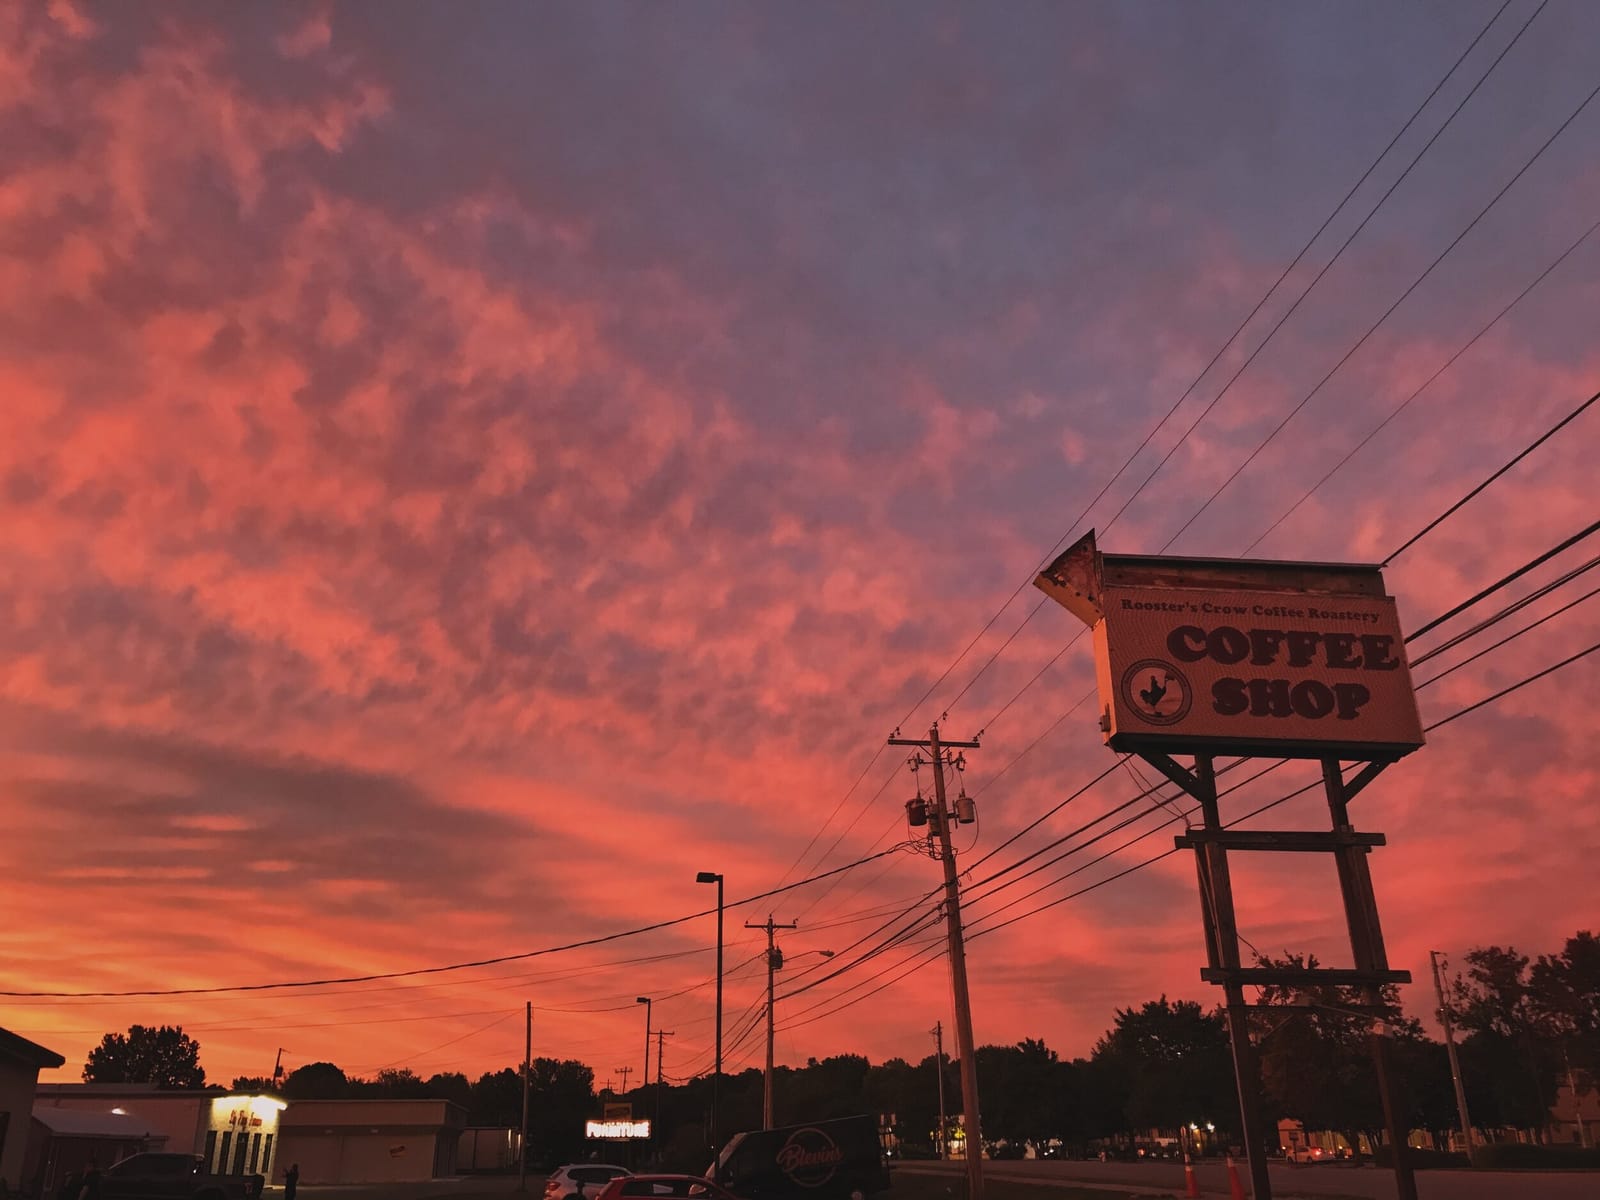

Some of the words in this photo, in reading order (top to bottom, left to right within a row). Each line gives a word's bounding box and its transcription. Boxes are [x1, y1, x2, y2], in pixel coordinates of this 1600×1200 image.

[1121, 599, 1197, 614] Rooster's
[1201, 602, 1248, 616] Crow
[1252, 605, 1305, 619] Coffee
[1308, 608, 1380, 623] Roastery
[1166, 625, 1400, 672] COFFEE
[1211, 677, 1371, 720] SHOP
